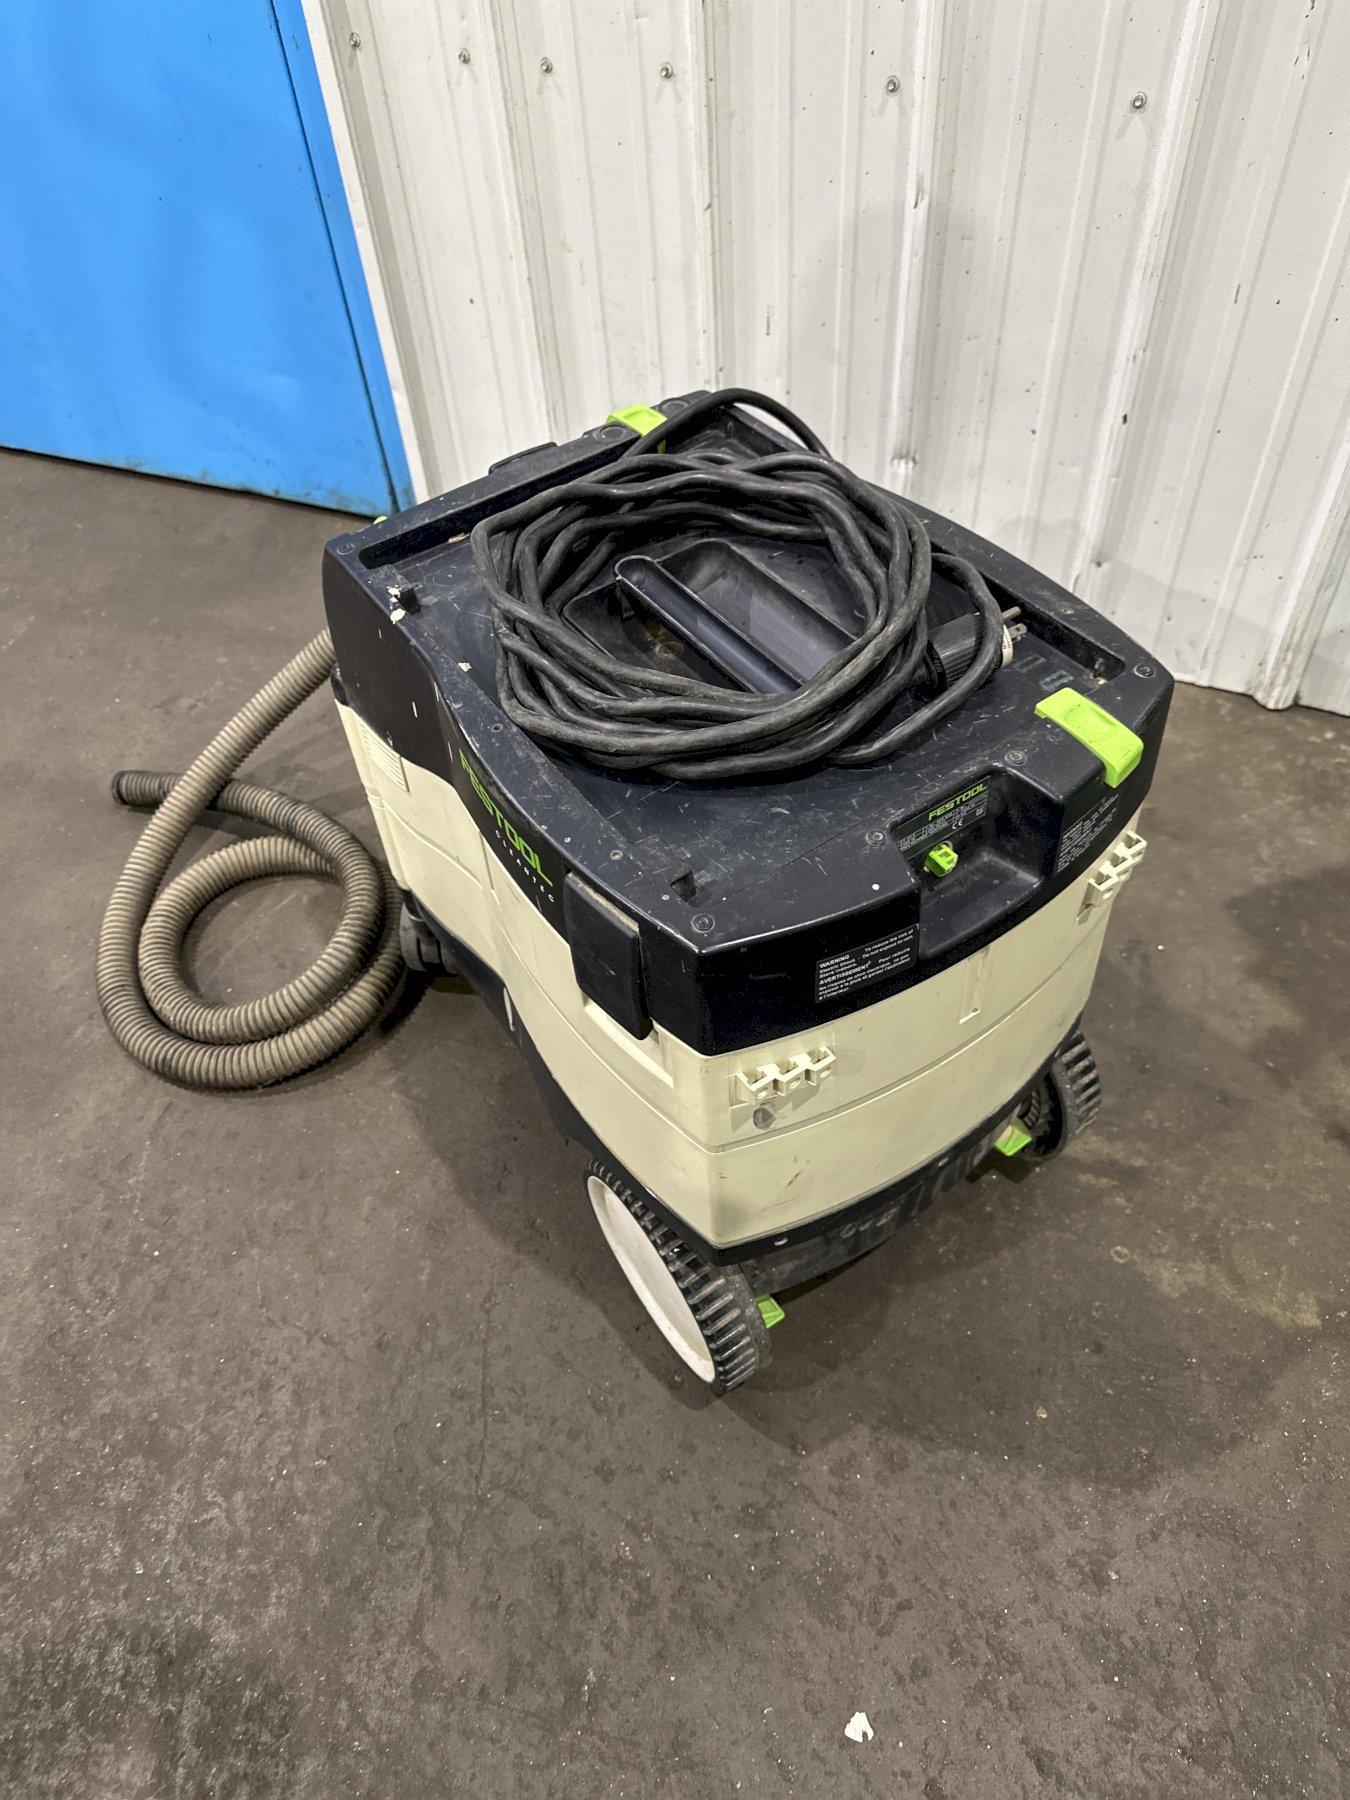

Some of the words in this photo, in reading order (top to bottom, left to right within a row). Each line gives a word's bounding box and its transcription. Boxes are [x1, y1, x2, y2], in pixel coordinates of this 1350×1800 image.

[459, 748, 553, 887] FESTOOL
[928, 783, 987, 821] FESTOOL
[819, 954, 850, 968] WARNING
[872, 940, 889, 950] reduce
